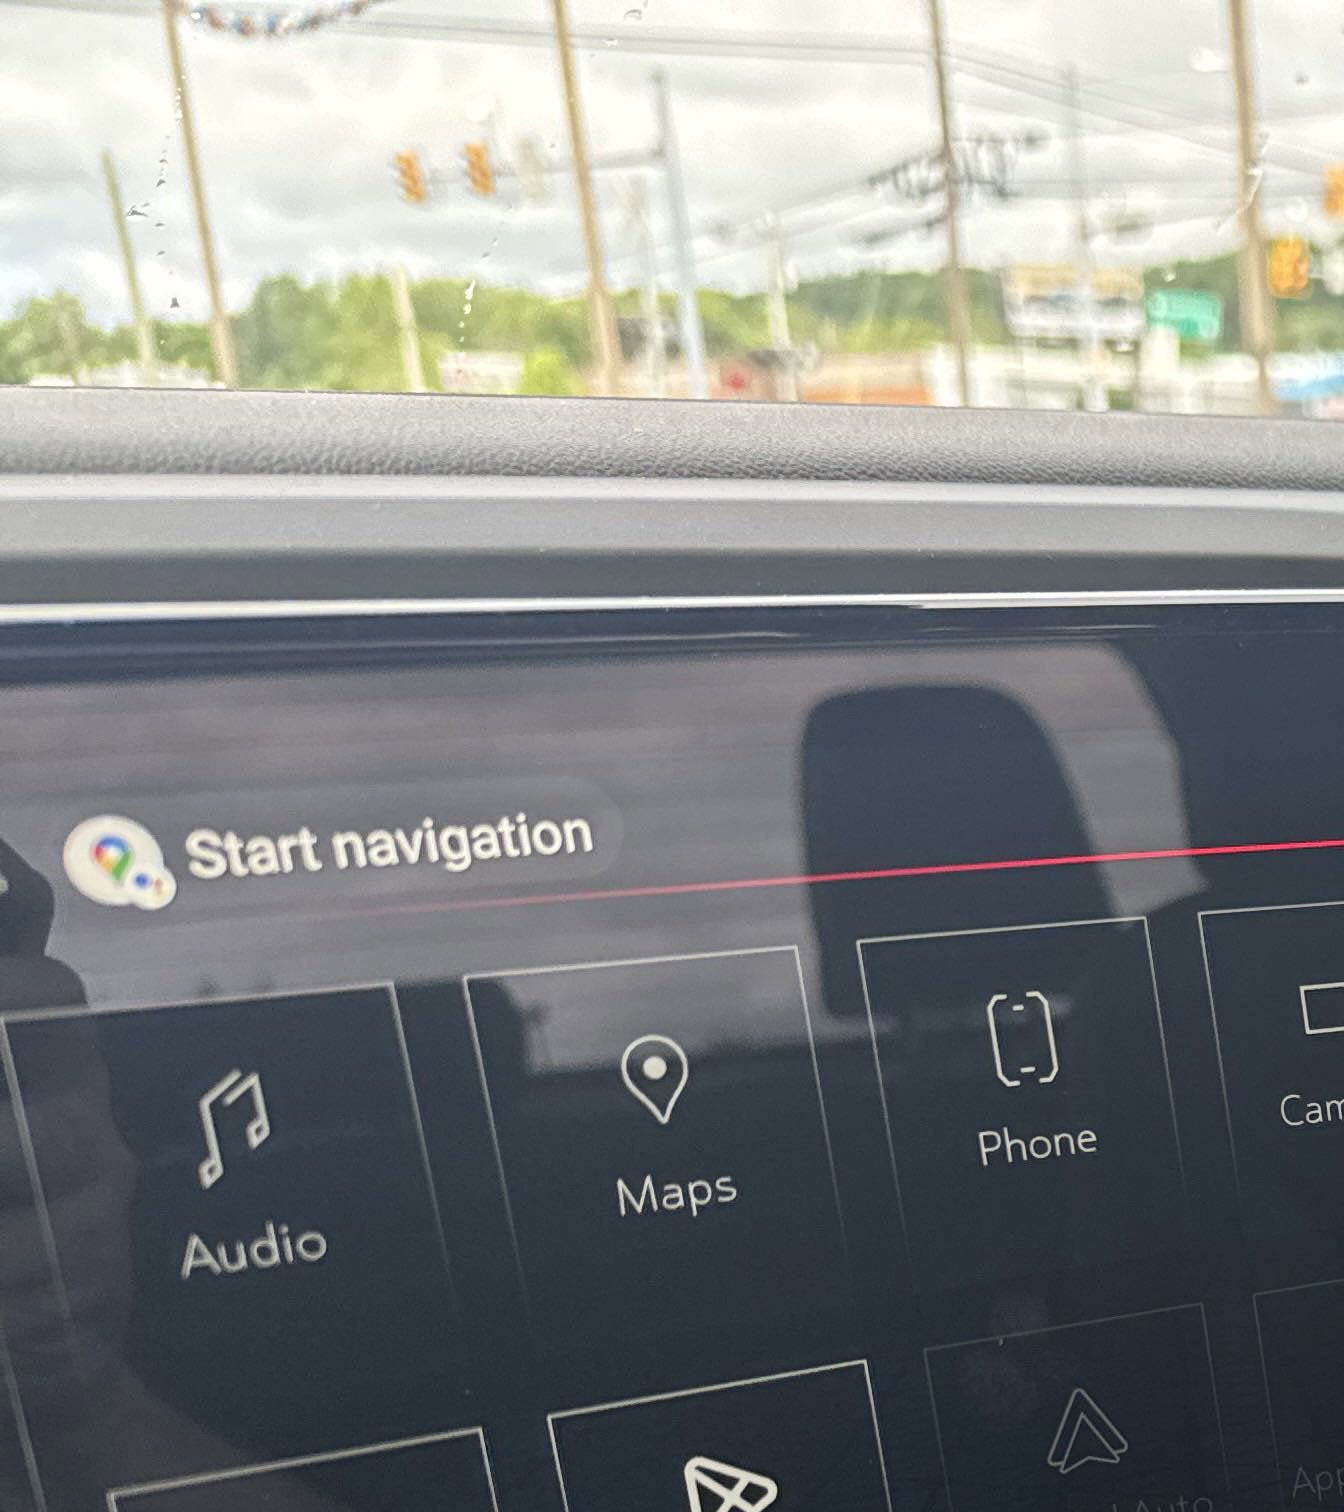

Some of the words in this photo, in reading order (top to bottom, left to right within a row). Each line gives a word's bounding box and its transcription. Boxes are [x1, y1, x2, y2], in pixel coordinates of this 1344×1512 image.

[186, 828, 322, 880] Start
[332, 811, 595, 873] navigation
[977, 1122, 1099, 1167] Phone
[616, 1172, 738, 1219] Maps
[181, 1221, 329, 1279] Audio
